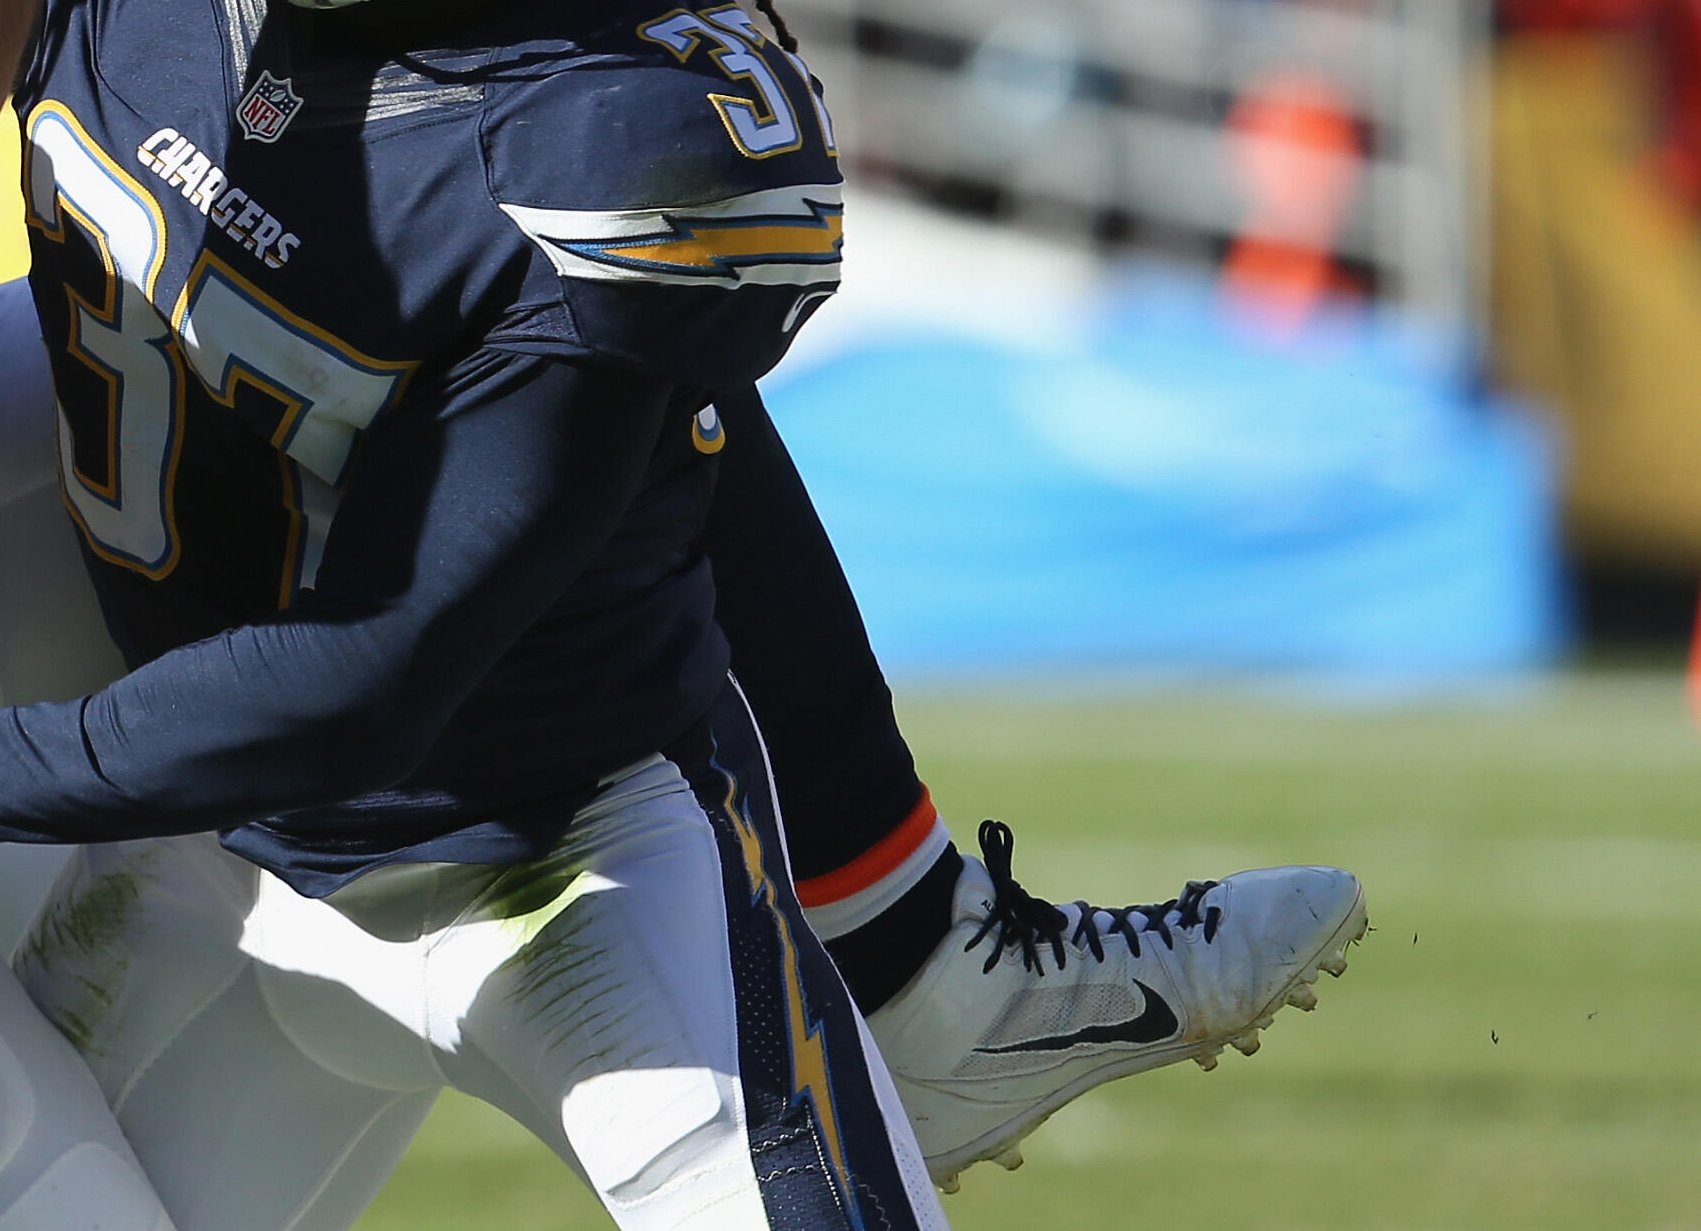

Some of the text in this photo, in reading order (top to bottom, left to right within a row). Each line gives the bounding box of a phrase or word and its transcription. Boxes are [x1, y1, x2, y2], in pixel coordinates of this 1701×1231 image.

[243, 95, 281, 136] NFL
[137, 128, 301, 269] CHARGERS
[26, 99, 422, 610] 37
